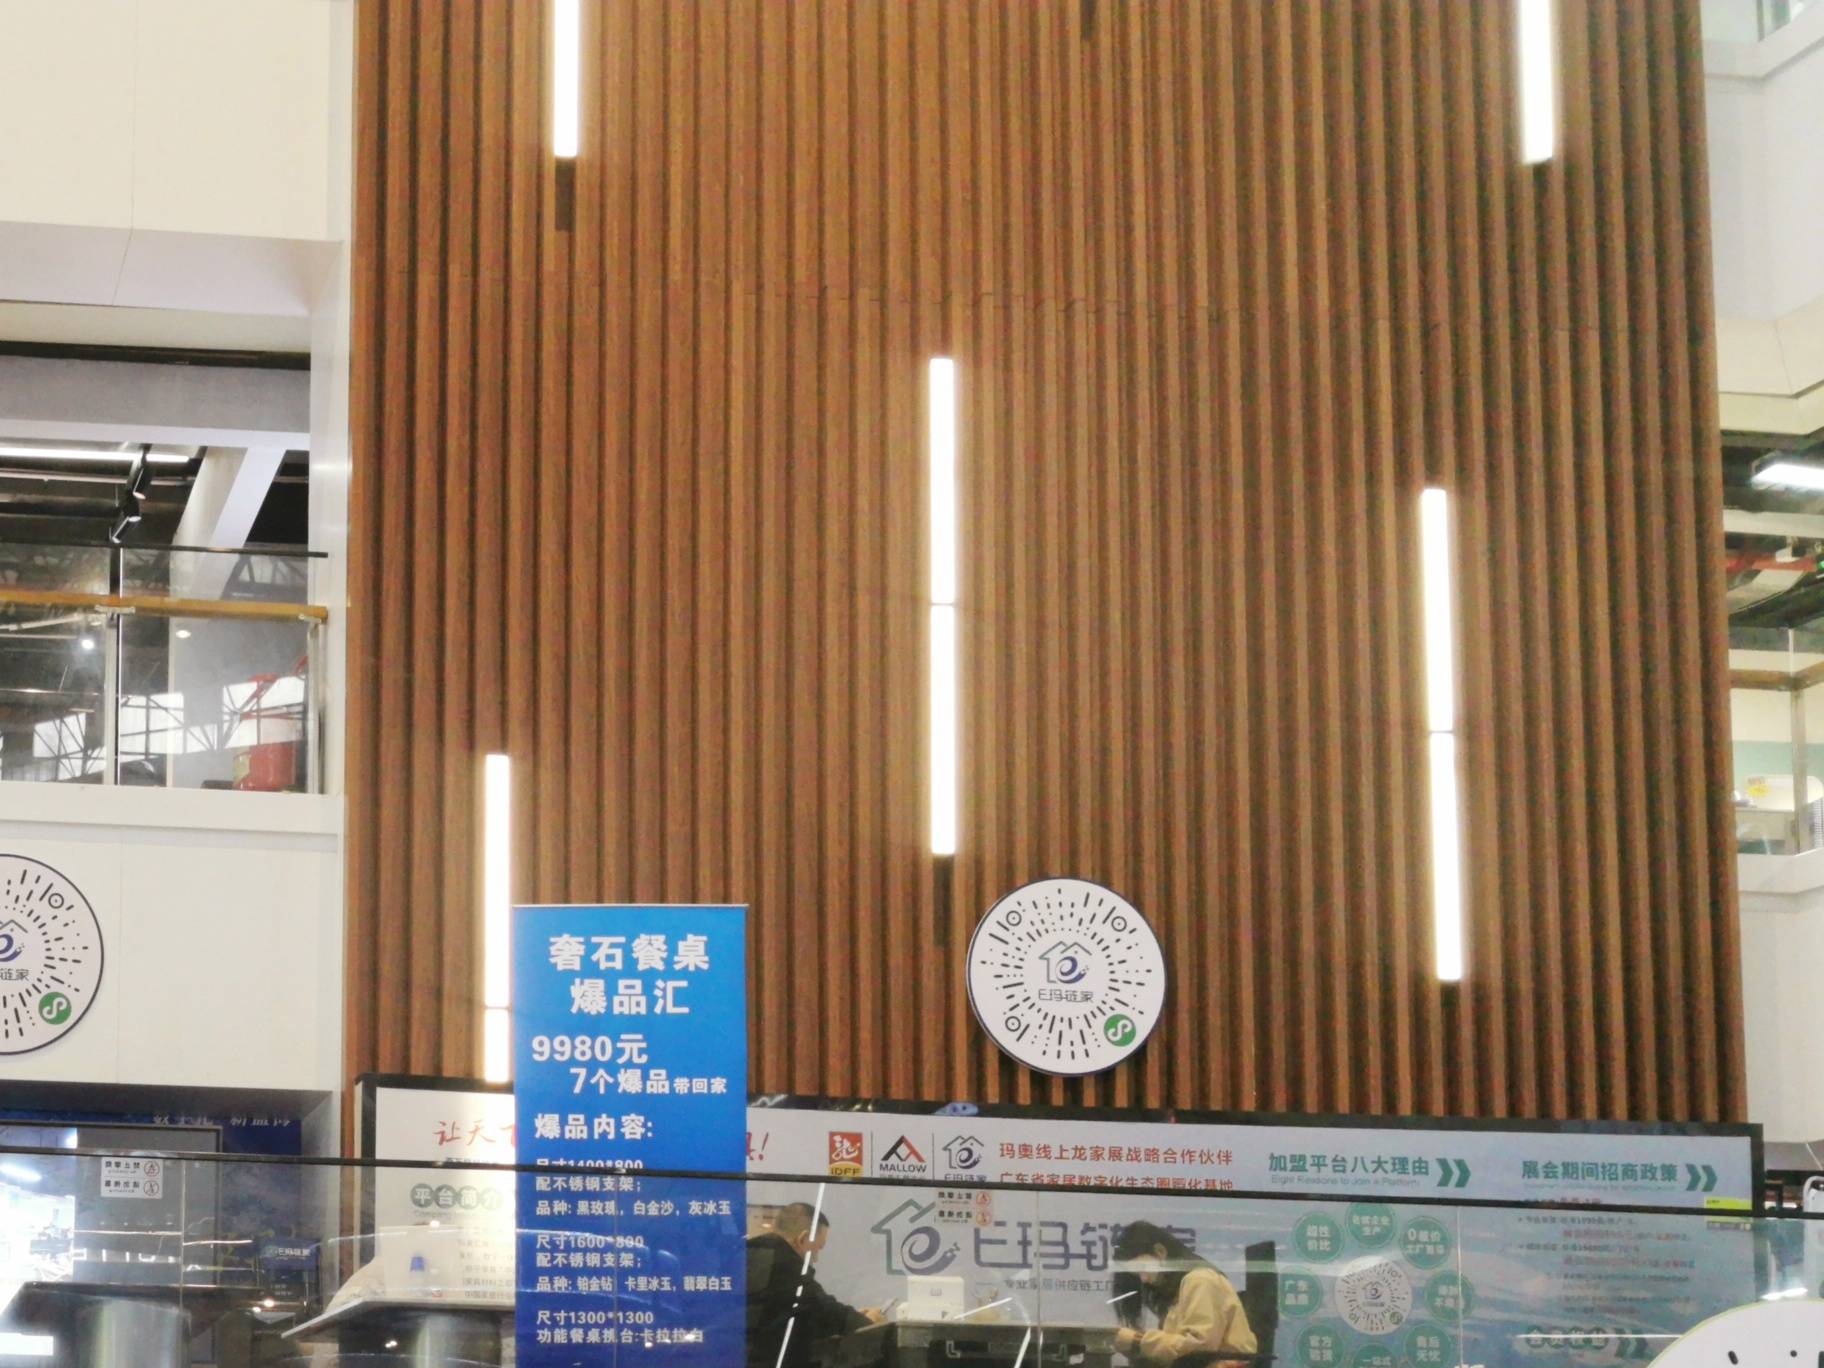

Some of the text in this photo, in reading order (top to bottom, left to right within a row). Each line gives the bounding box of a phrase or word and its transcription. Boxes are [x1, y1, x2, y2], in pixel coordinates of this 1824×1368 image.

[548, 933, 710, 972] 奢石餐桌
[569, 978, 690, 1015] 爆品汇
[1038, 989, 1095, 1004] E玛链家
[531, 1034, 648, 1064] 9980元
[999, 1142, 1234, 1167] 玛奥线上龙家展战略合作伙伴
[1268, 1153, 1430, 1177] 加盟平台八大理由
[878, 1162, 928, 1174] MALLOW
[1522, 1159, 1679, 1182] 展会期间招商政策
